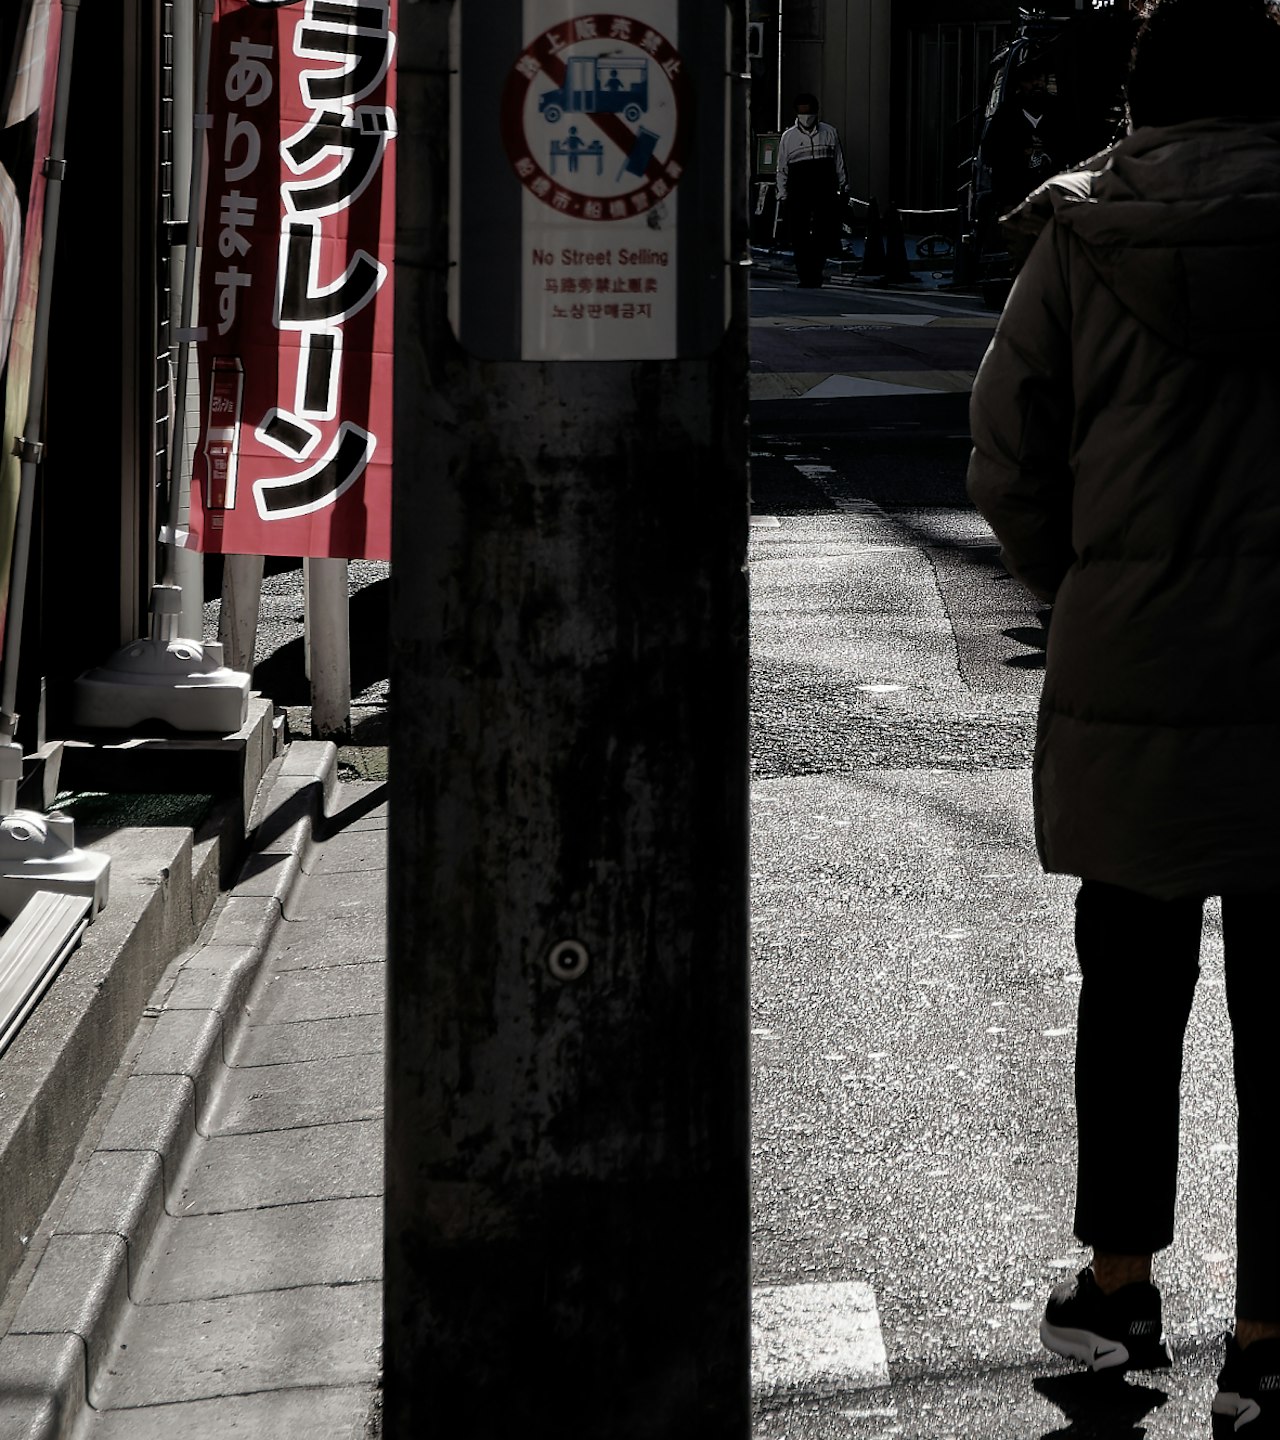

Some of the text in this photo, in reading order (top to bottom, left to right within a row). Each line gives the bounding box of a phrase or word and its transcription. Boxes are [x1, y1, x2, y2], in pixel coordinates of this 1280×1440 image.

[213, 35, 274, 337] あります
[532, 248, 669, 267] No Street Selling
[551, 303, 653, 320] 노상판매금지
